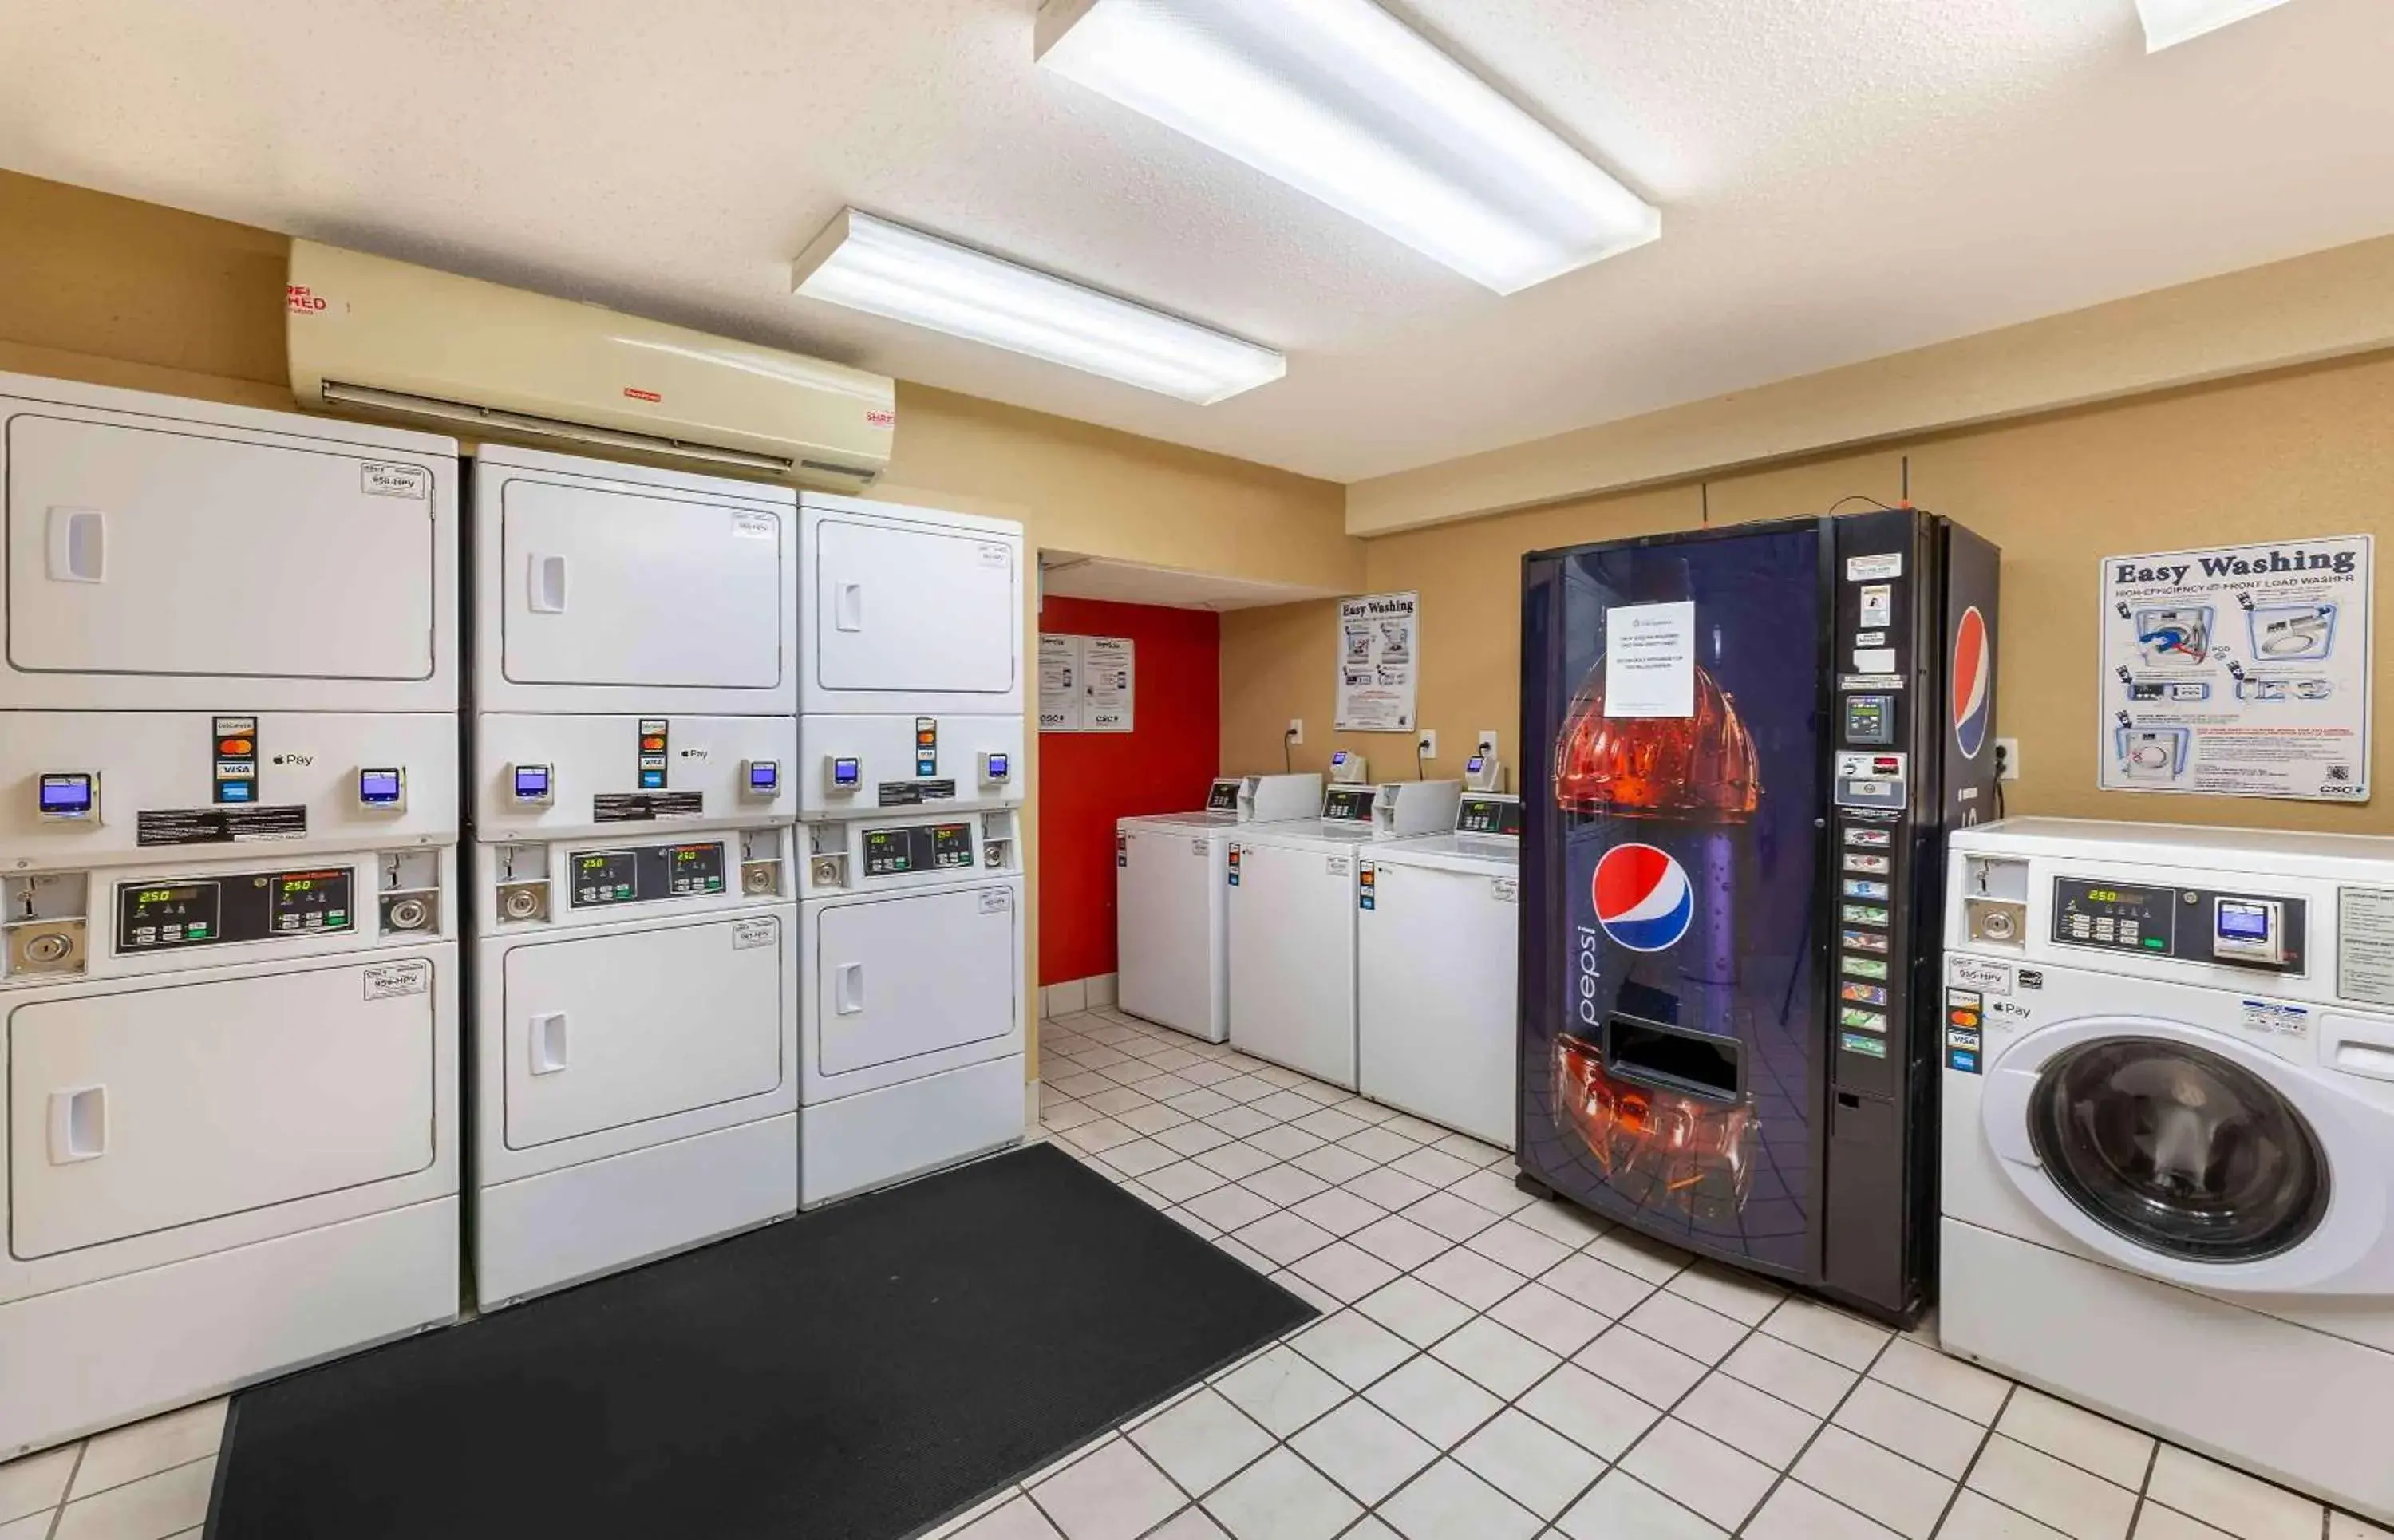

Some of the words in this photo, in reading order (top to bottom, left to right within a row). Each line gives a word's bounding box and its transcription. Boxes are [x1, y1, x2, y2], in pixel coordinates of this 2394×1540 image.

[2115, 564, 2190, 586] Easy
[2198, 550, 2356, 578] Washing
[2223, 579, 2262, 590] FRONT
[2265, 578, 2297, 588] LOAD
[2301, 573, 2355, 586] WASHER
[1343, 604, 1367, 618] Easy
[1368, 599, 1414, 614] Washing
[286, 754, 314, 766] Pay
[1577, 925, 1601, 1027] pepsi
[2005, 1003, 2031, 1018] Pay
[1953, 1035, 1977, 1045] VISA
